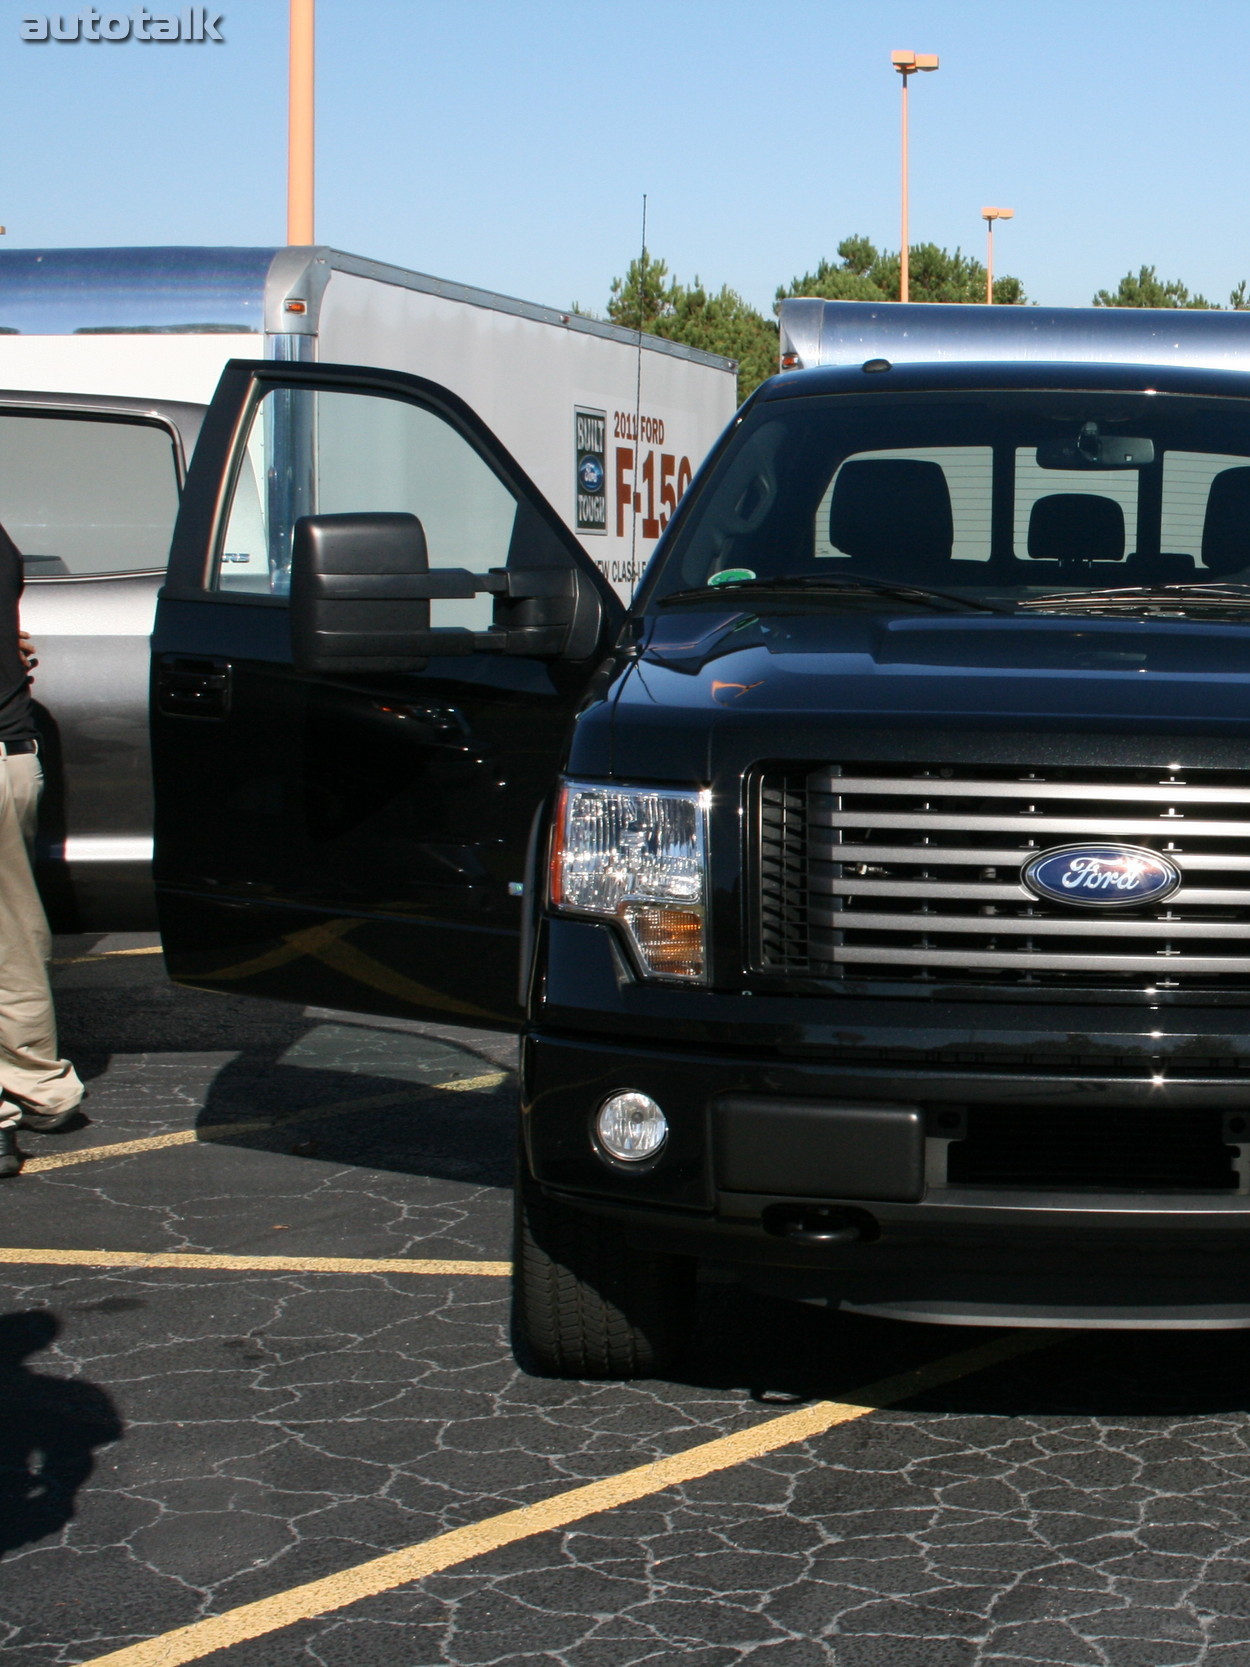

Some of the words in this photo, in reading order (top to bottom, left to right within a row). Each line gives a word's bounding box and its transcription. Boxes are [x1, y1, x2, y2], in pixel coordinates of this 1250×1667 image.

[577, 416, 605, 453] BUILT
[613, 410, 639, 440] 2011
[640, 416, 665, 446] FORD
[578, 494, 605, 523] TOUGH
[1061, 856, 1140, 890] Ford
